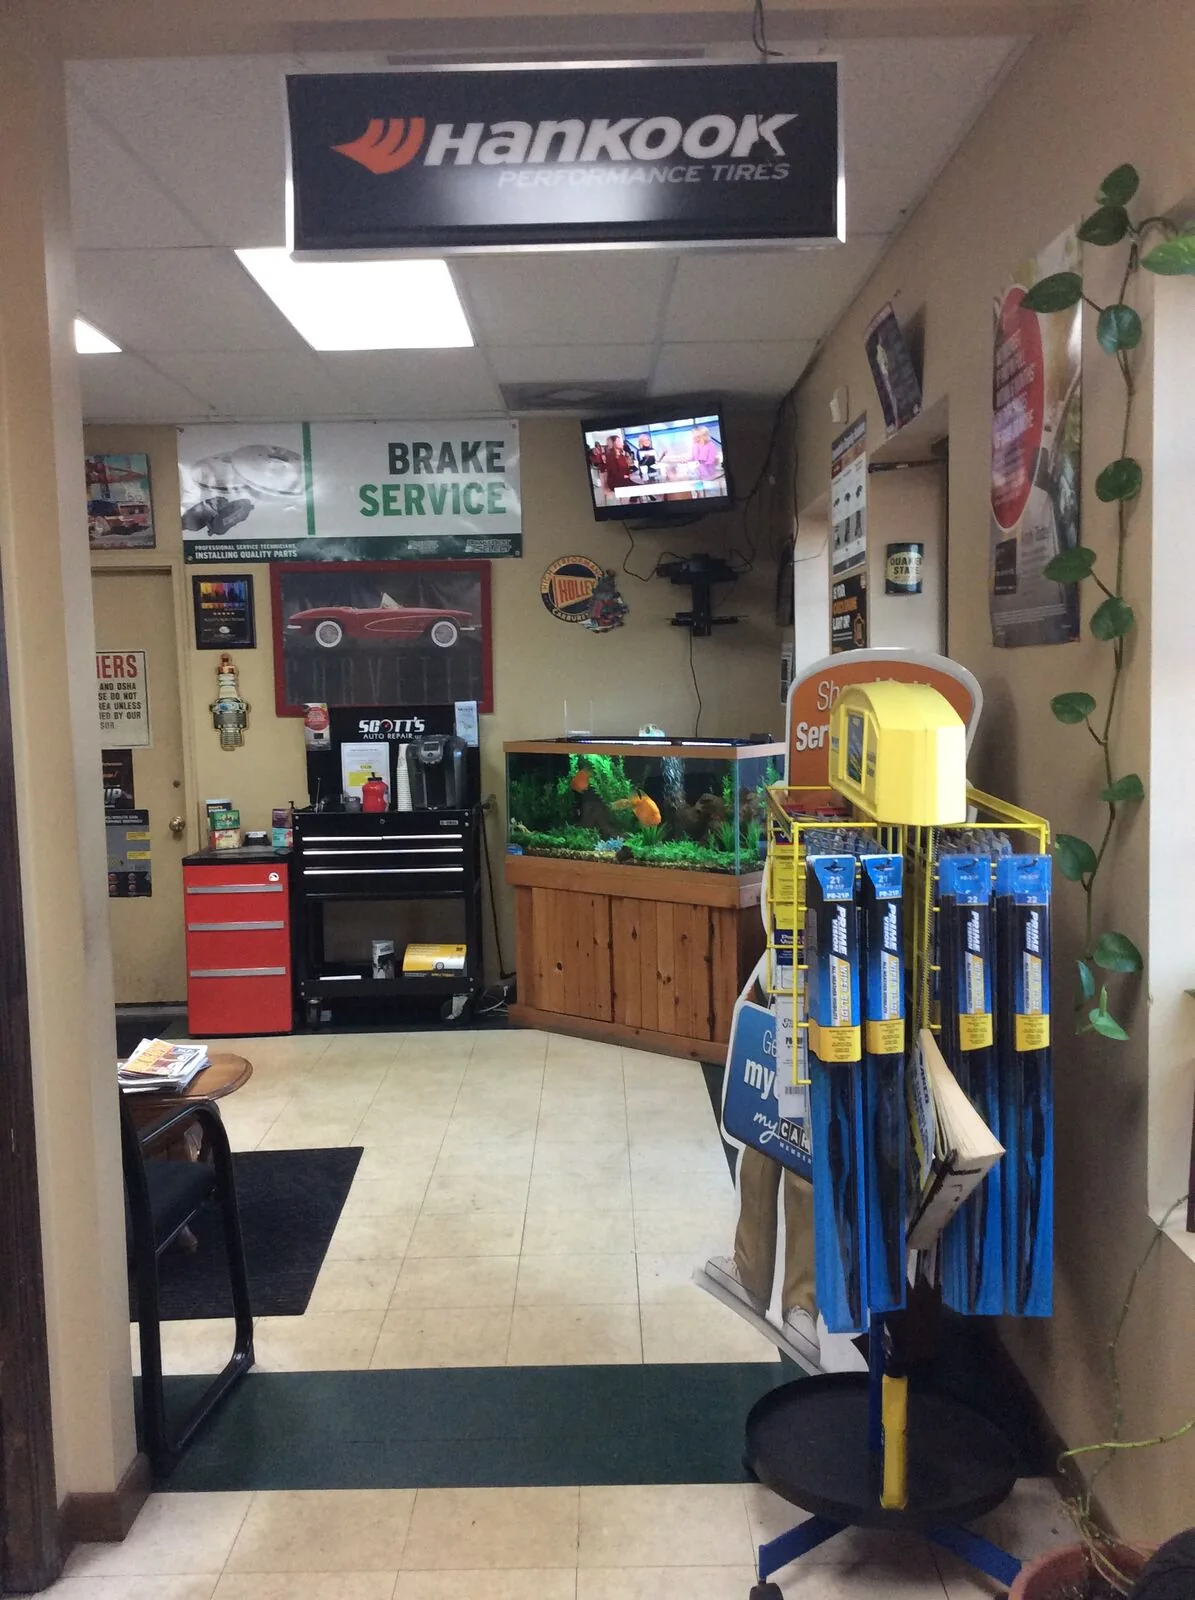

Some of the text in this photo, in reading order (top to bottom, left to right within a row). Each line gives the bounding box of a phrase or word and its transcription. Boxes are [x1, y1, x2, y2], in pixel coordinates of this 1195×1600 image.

[497, 162, 790, 188] PERFORMANCE TIRES
[388, 441, 505, 475] BRAKE
[358, 482, 506, 517] SERVICE
[195, 550, 297, 560] INSTALLING QUALITY PARTS
[893, 566, 921, 575] STATE
[110, 692, 120, 700] DO
[123, 692, 137, 700] NOT
[117, 682, 136, 690] OSHA
[114, 701, 141, 710] UNLESS
[126, 711, 141, 719] OUR
[358, 716, 426, 733] SCOTT'S
[831, 918, 839, 953] VISION
[837, 904, 848, 956] PRIME
[887, 902, 897, 952] PRIME
[971, 910, 980, 952] PRIME
[1030, 910, 1039, 952] PRIME
